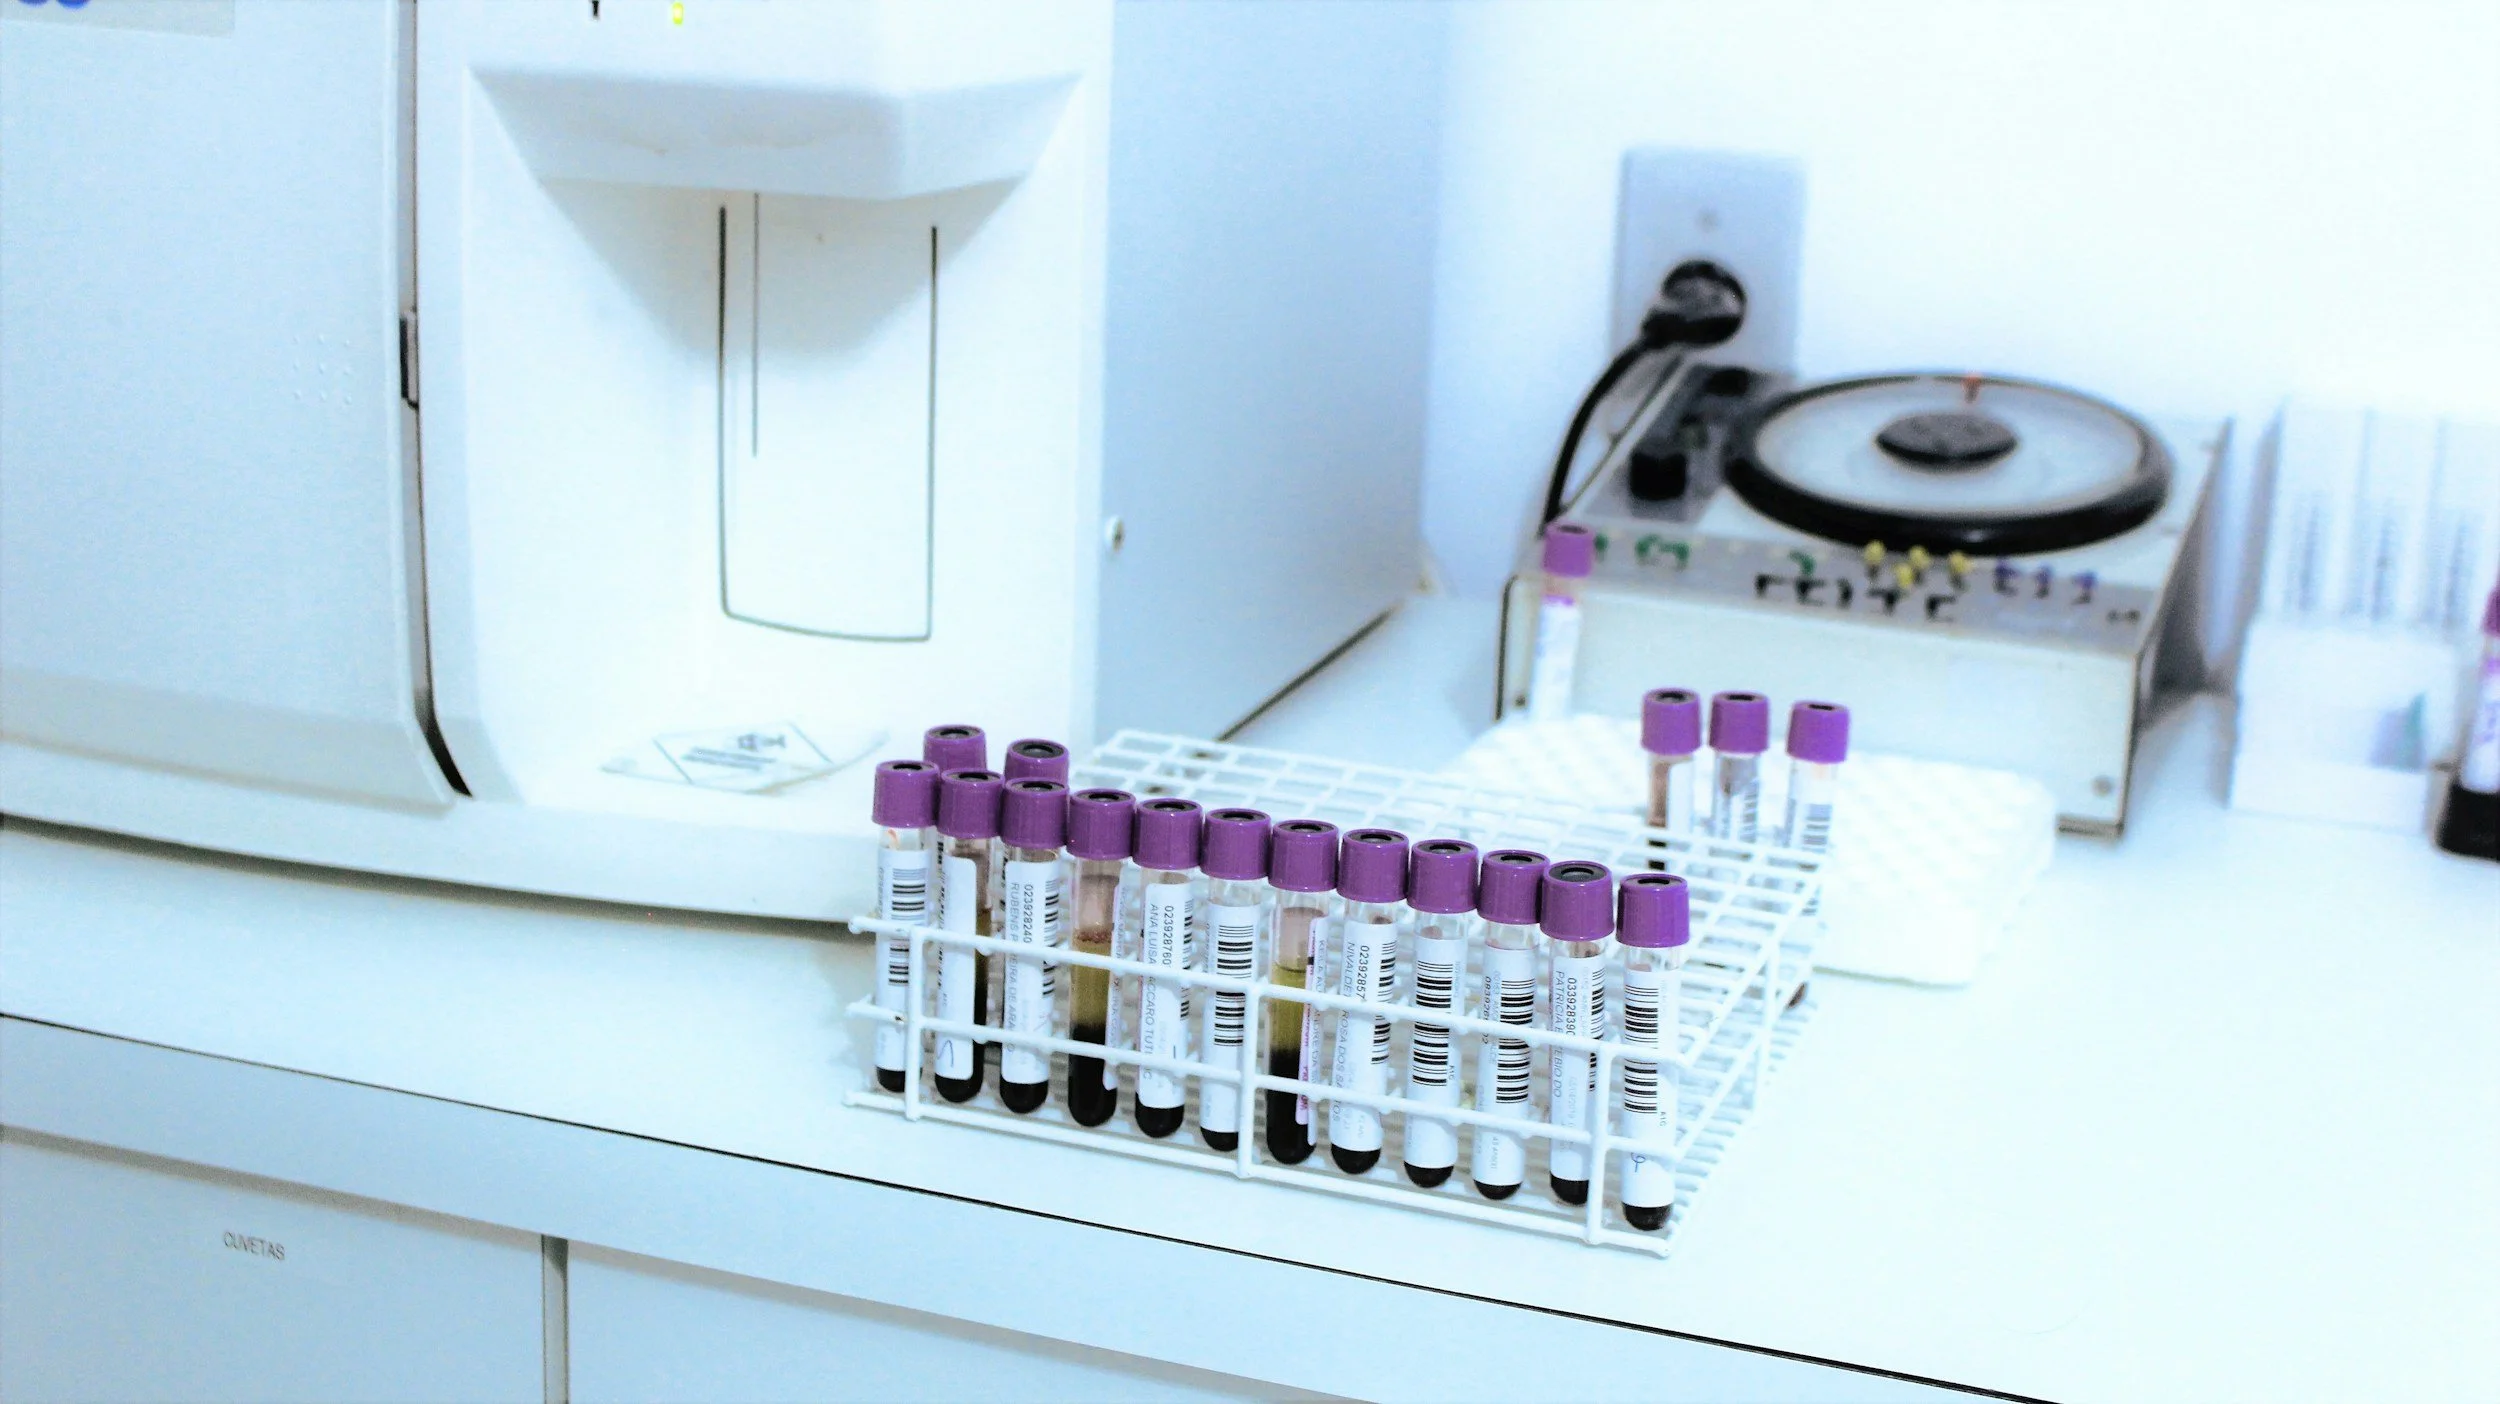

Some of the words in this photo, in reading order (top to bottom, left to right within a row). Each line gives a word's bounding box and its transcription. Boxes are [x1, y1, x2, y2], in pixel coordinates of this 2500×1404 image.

[1010, 882, 1020, 931] RUBENS
[1149, 903, 1159, 928] ANA
[1008, 934, 1019, 983] PEIRA
[1148, 931, 1159, 964] LUISA
[1356, 945, 1370, 1001] 02392857
[1145, 975, 1156, 1026] ACCARO
[1555, 971, 1566, 1024] PATRICIA
[1006, 1005, 1018, 1053] ARAO
[1339, 1010, 1350, 1042] ROSA
[1336, 1045, 1347, 1072] DOS
[1553, 1027, 1565, 1078] EEBIO
[1553, 1079, 1563, 1098] DO
